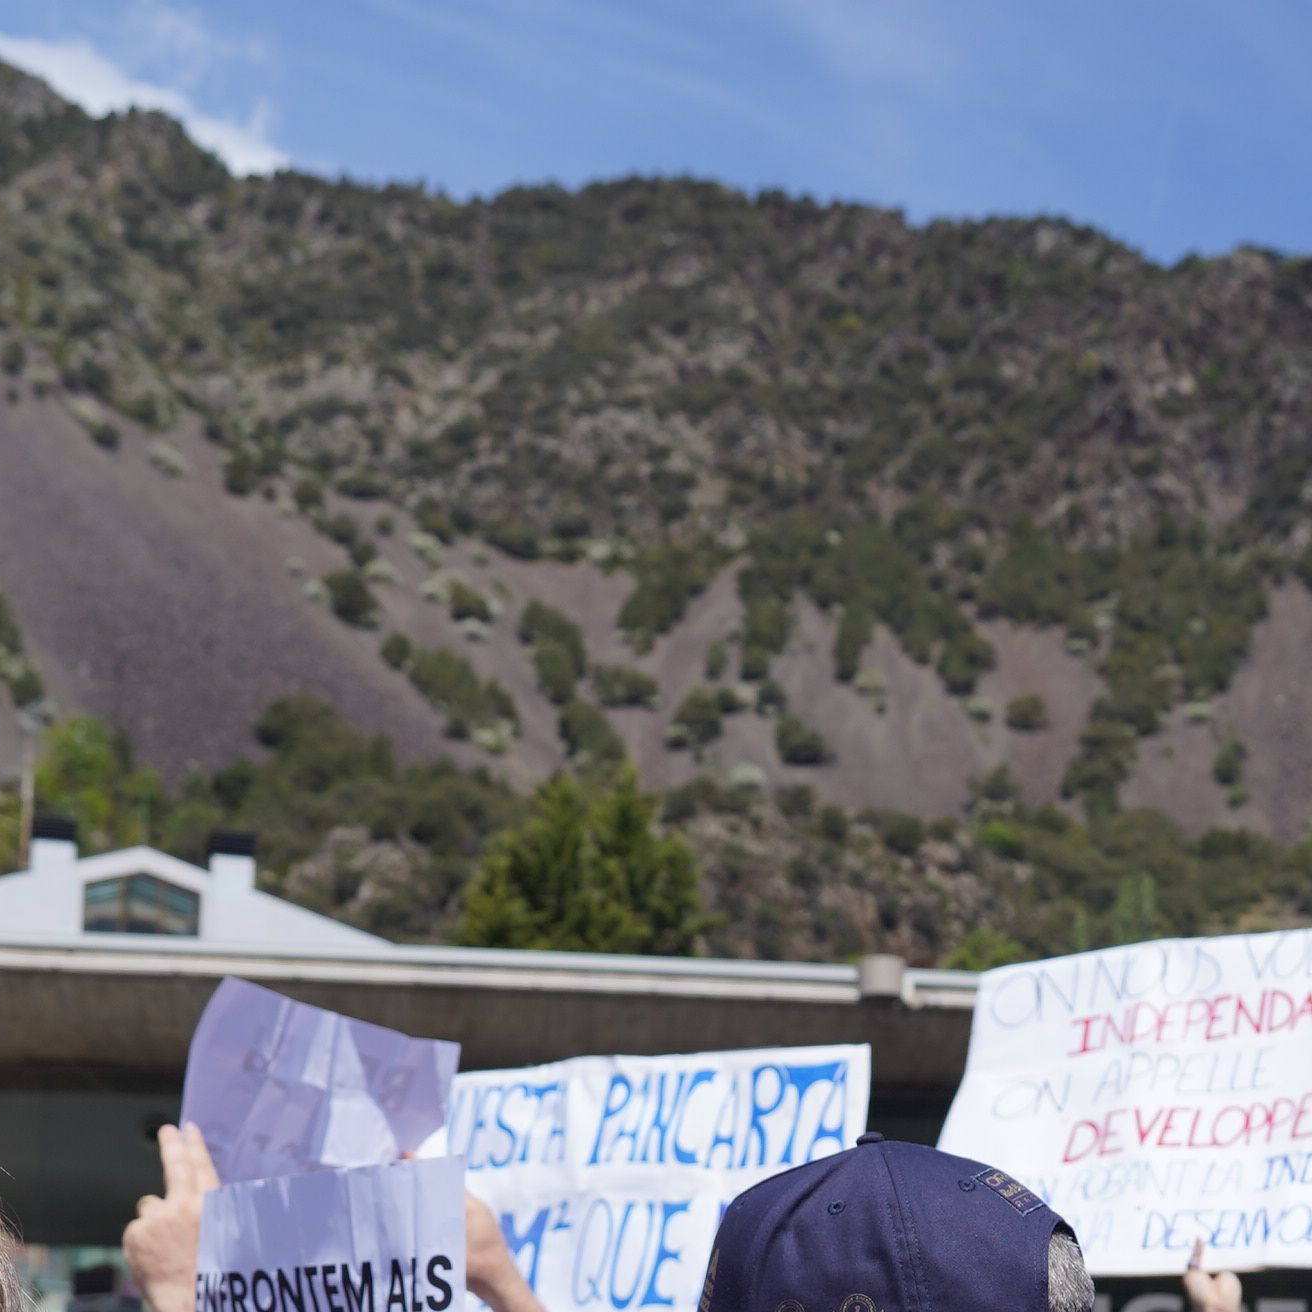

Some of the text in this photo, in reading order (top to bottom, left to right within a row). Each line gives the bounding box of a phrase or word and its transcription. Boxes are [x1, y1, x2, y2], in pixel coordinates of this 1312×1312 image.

[990, 962, 1080, 1028] ON
[1090, 944, 1223, 1008] NOUS
[587, 1061, 848, 1170] PANCARTA
[991, 1077, 1072, 1119] ON
[1091, 1046, 1276, 1101] APPELLE
[386, 1255, 453, 1312] ALS
[573, 1198, 690, 1309] QUE
